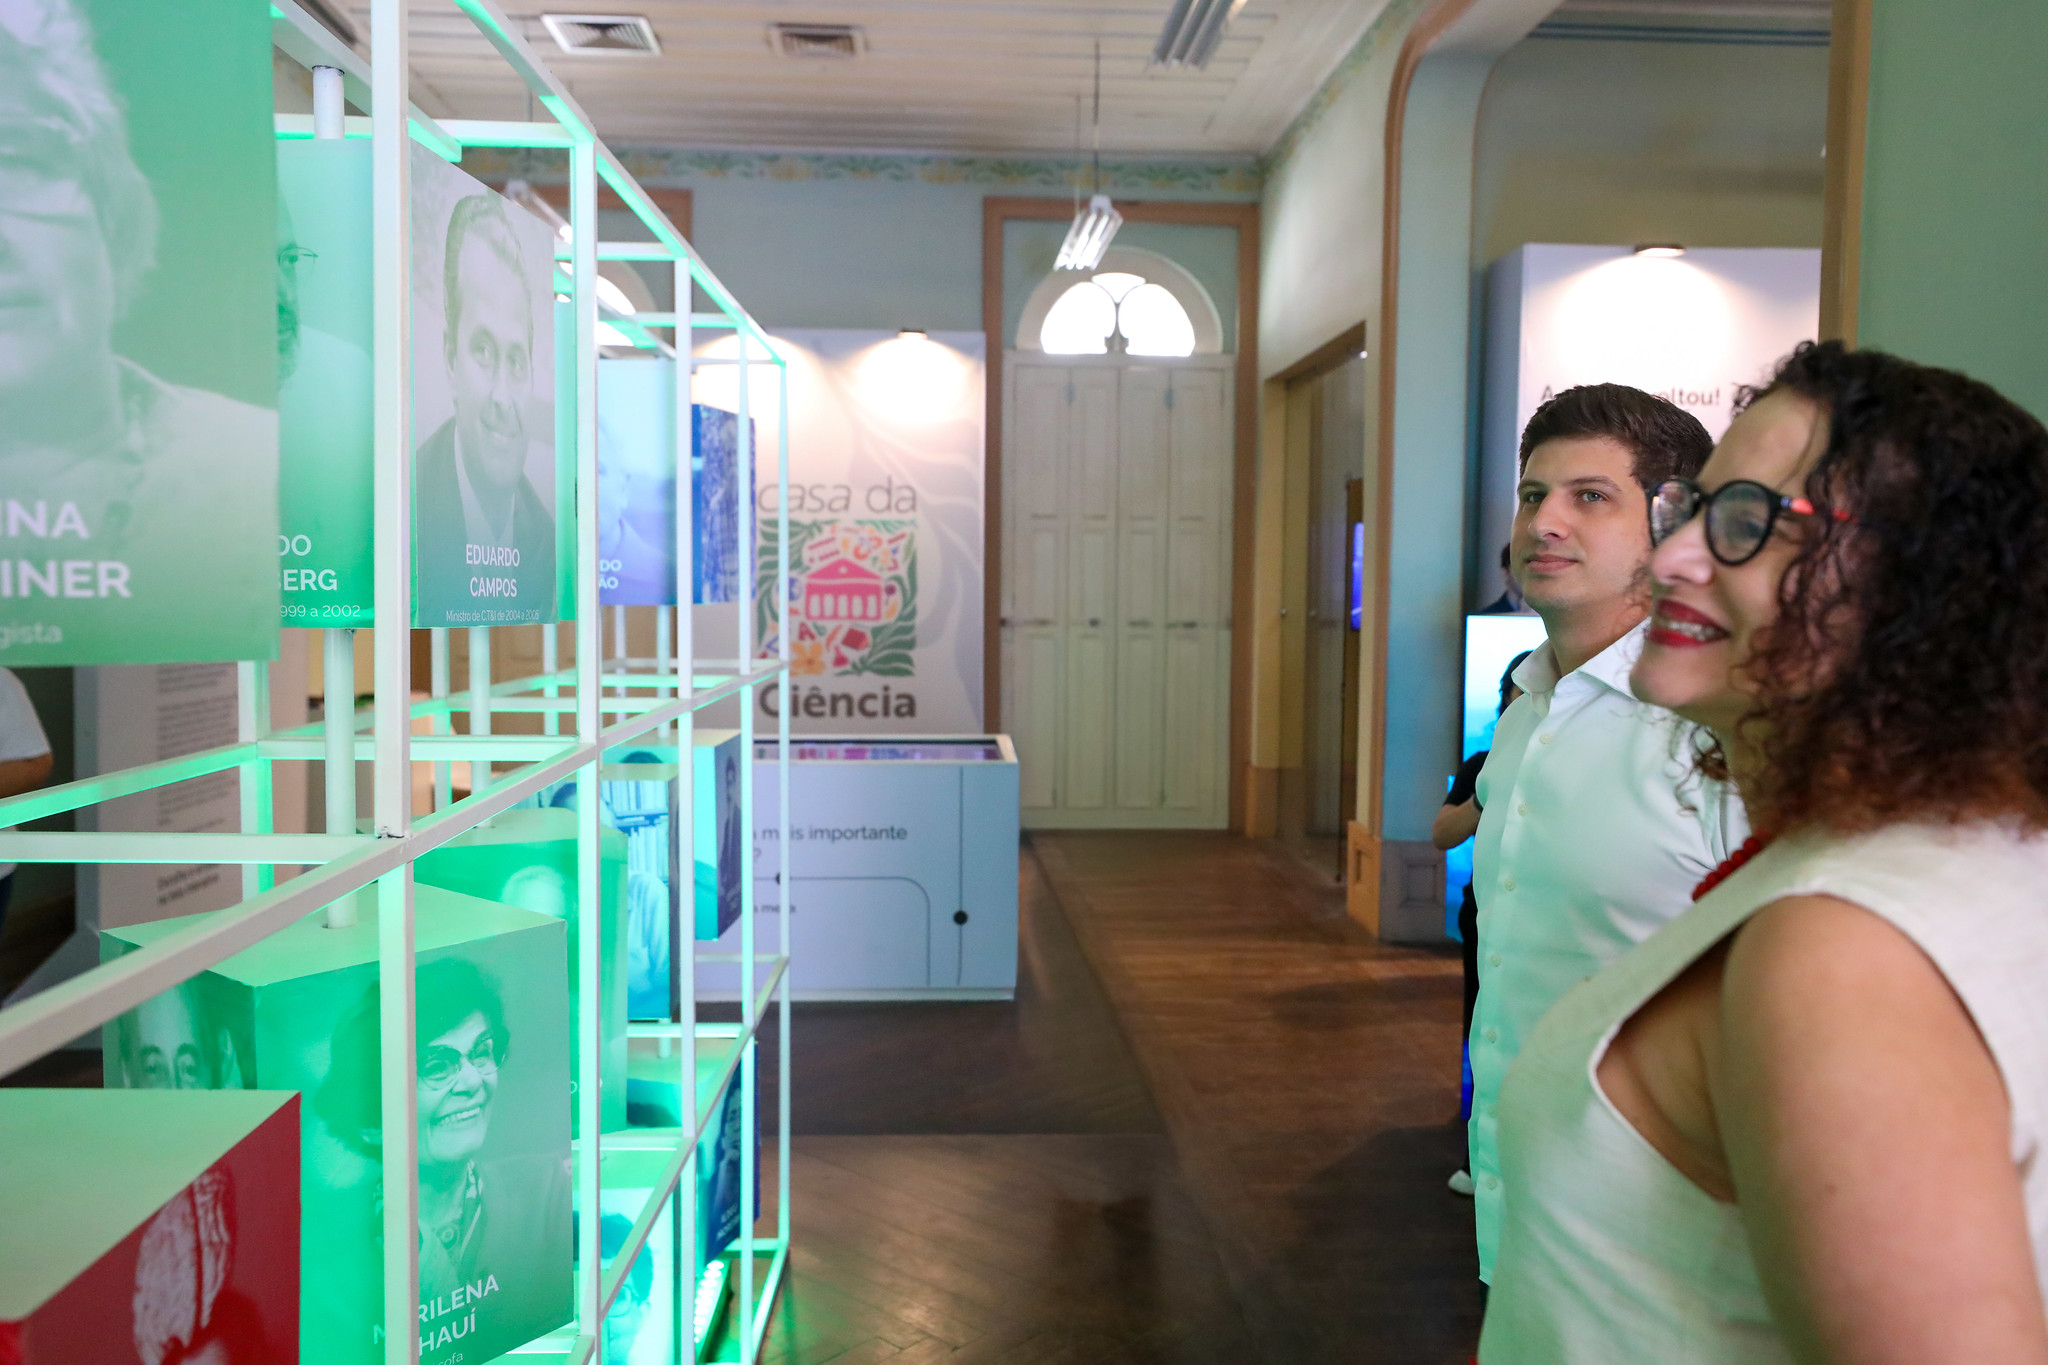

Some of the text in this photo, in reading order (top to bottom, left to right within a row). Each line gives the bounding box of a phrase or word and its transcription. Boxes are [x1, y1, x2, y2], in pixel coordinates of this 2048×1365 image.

[758, 475, 918, 513] casa da
[0, 500, 89, 538] NA
[465, 543, 521, 567] EDUARDO
[279, 569, 337, 591] ERG
[469, 576, 518, 598] CAMPOS
[310, 607, 319, 617] a
[322, 605, 361, 618] 2002
[446, 609, 471, 622] Ministro
[471, 610, 481, 621] de
[497, 610, 505, 621] de
[505, 609, 521, 621] 2004
[759, 682, 917, 718] Ciência
[762, 827, 804, 840] mis
[809, 823, 908, 844] importante
